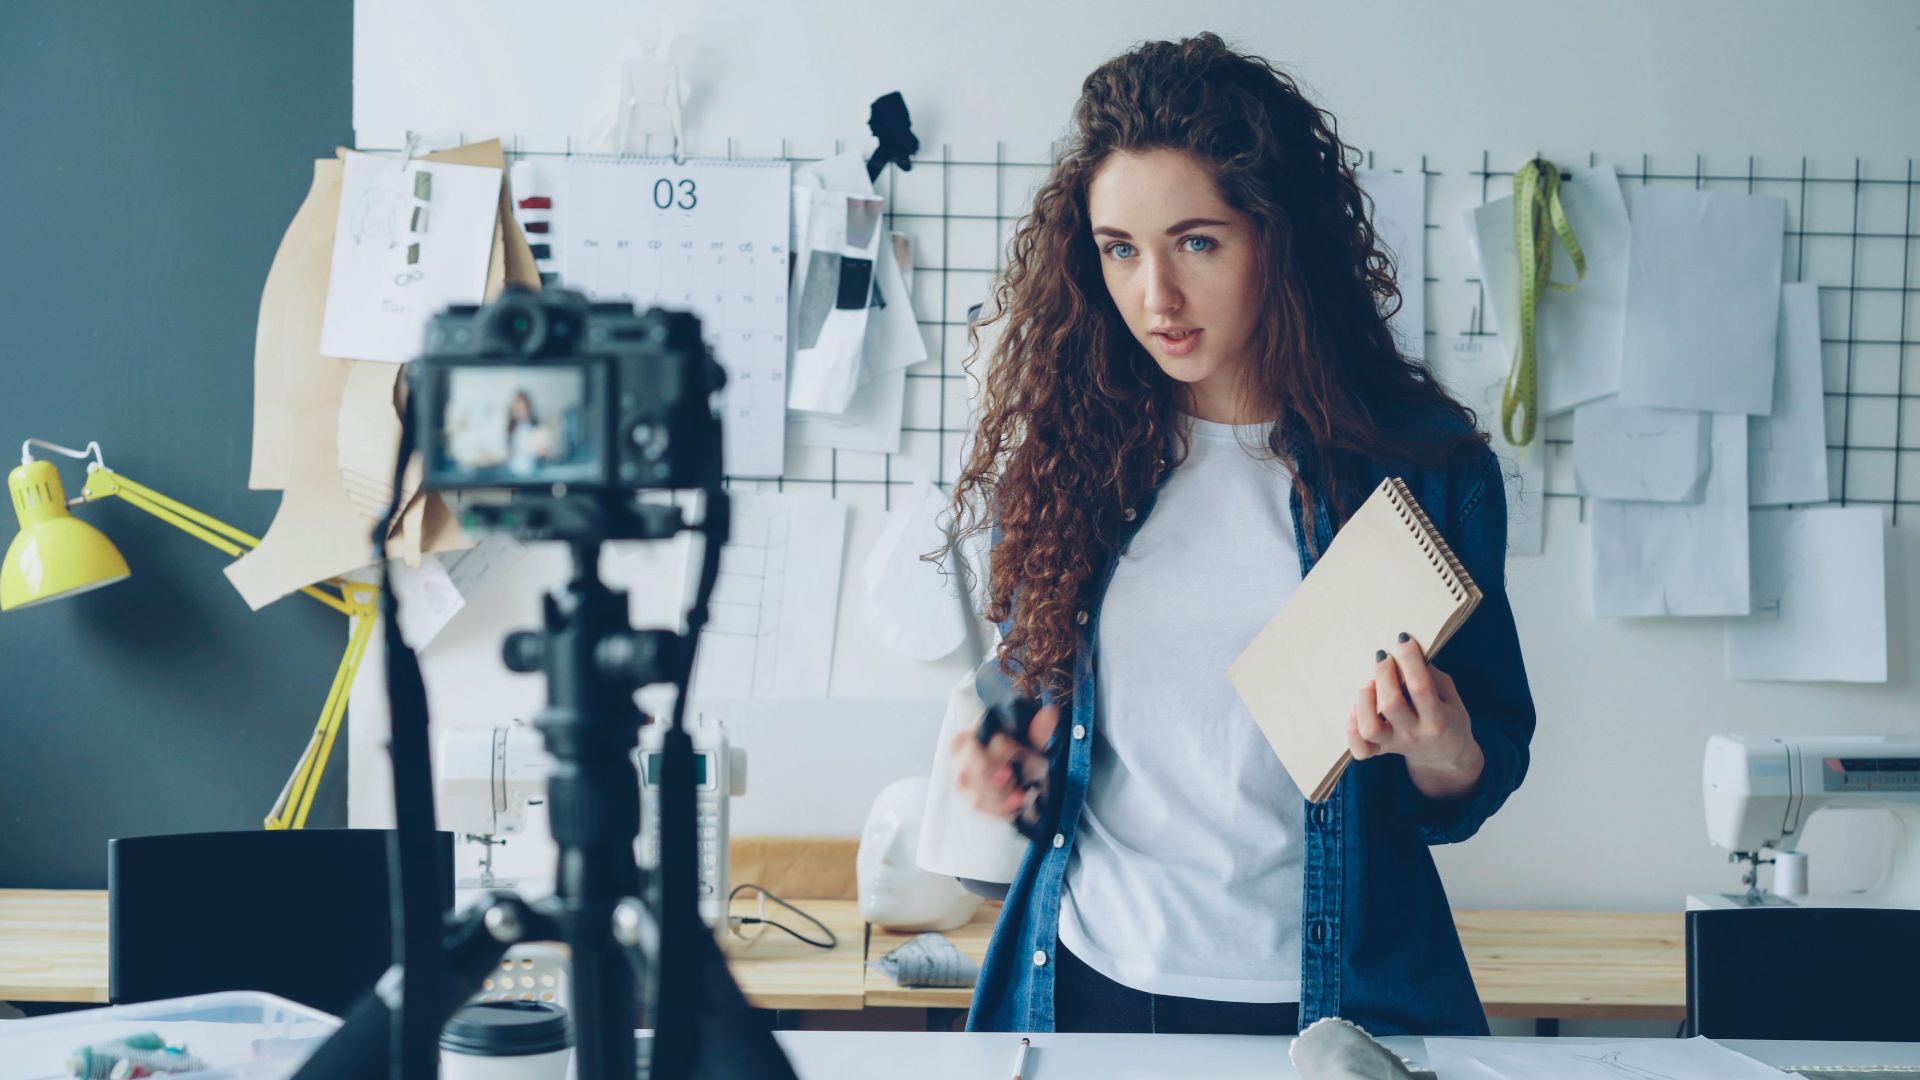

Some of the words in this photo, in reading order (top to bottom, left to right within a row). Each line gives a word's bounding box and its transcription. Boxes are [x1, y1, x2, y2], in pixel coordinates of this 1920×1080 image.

[653, 178, 697, 210] 03
[583, 239, 599, 248] пн
[616, 240, 630, 249] вт
[647, 240, 663, 253] ср
[680, 240, 694, 249] чт
[710, 241, 725, 250] пт
[738, 240, 754, 252] сб
[772, 244, 785, 253] вс
[742, 333, 753, 341] 17
[740, 372, 751, 380] 24
